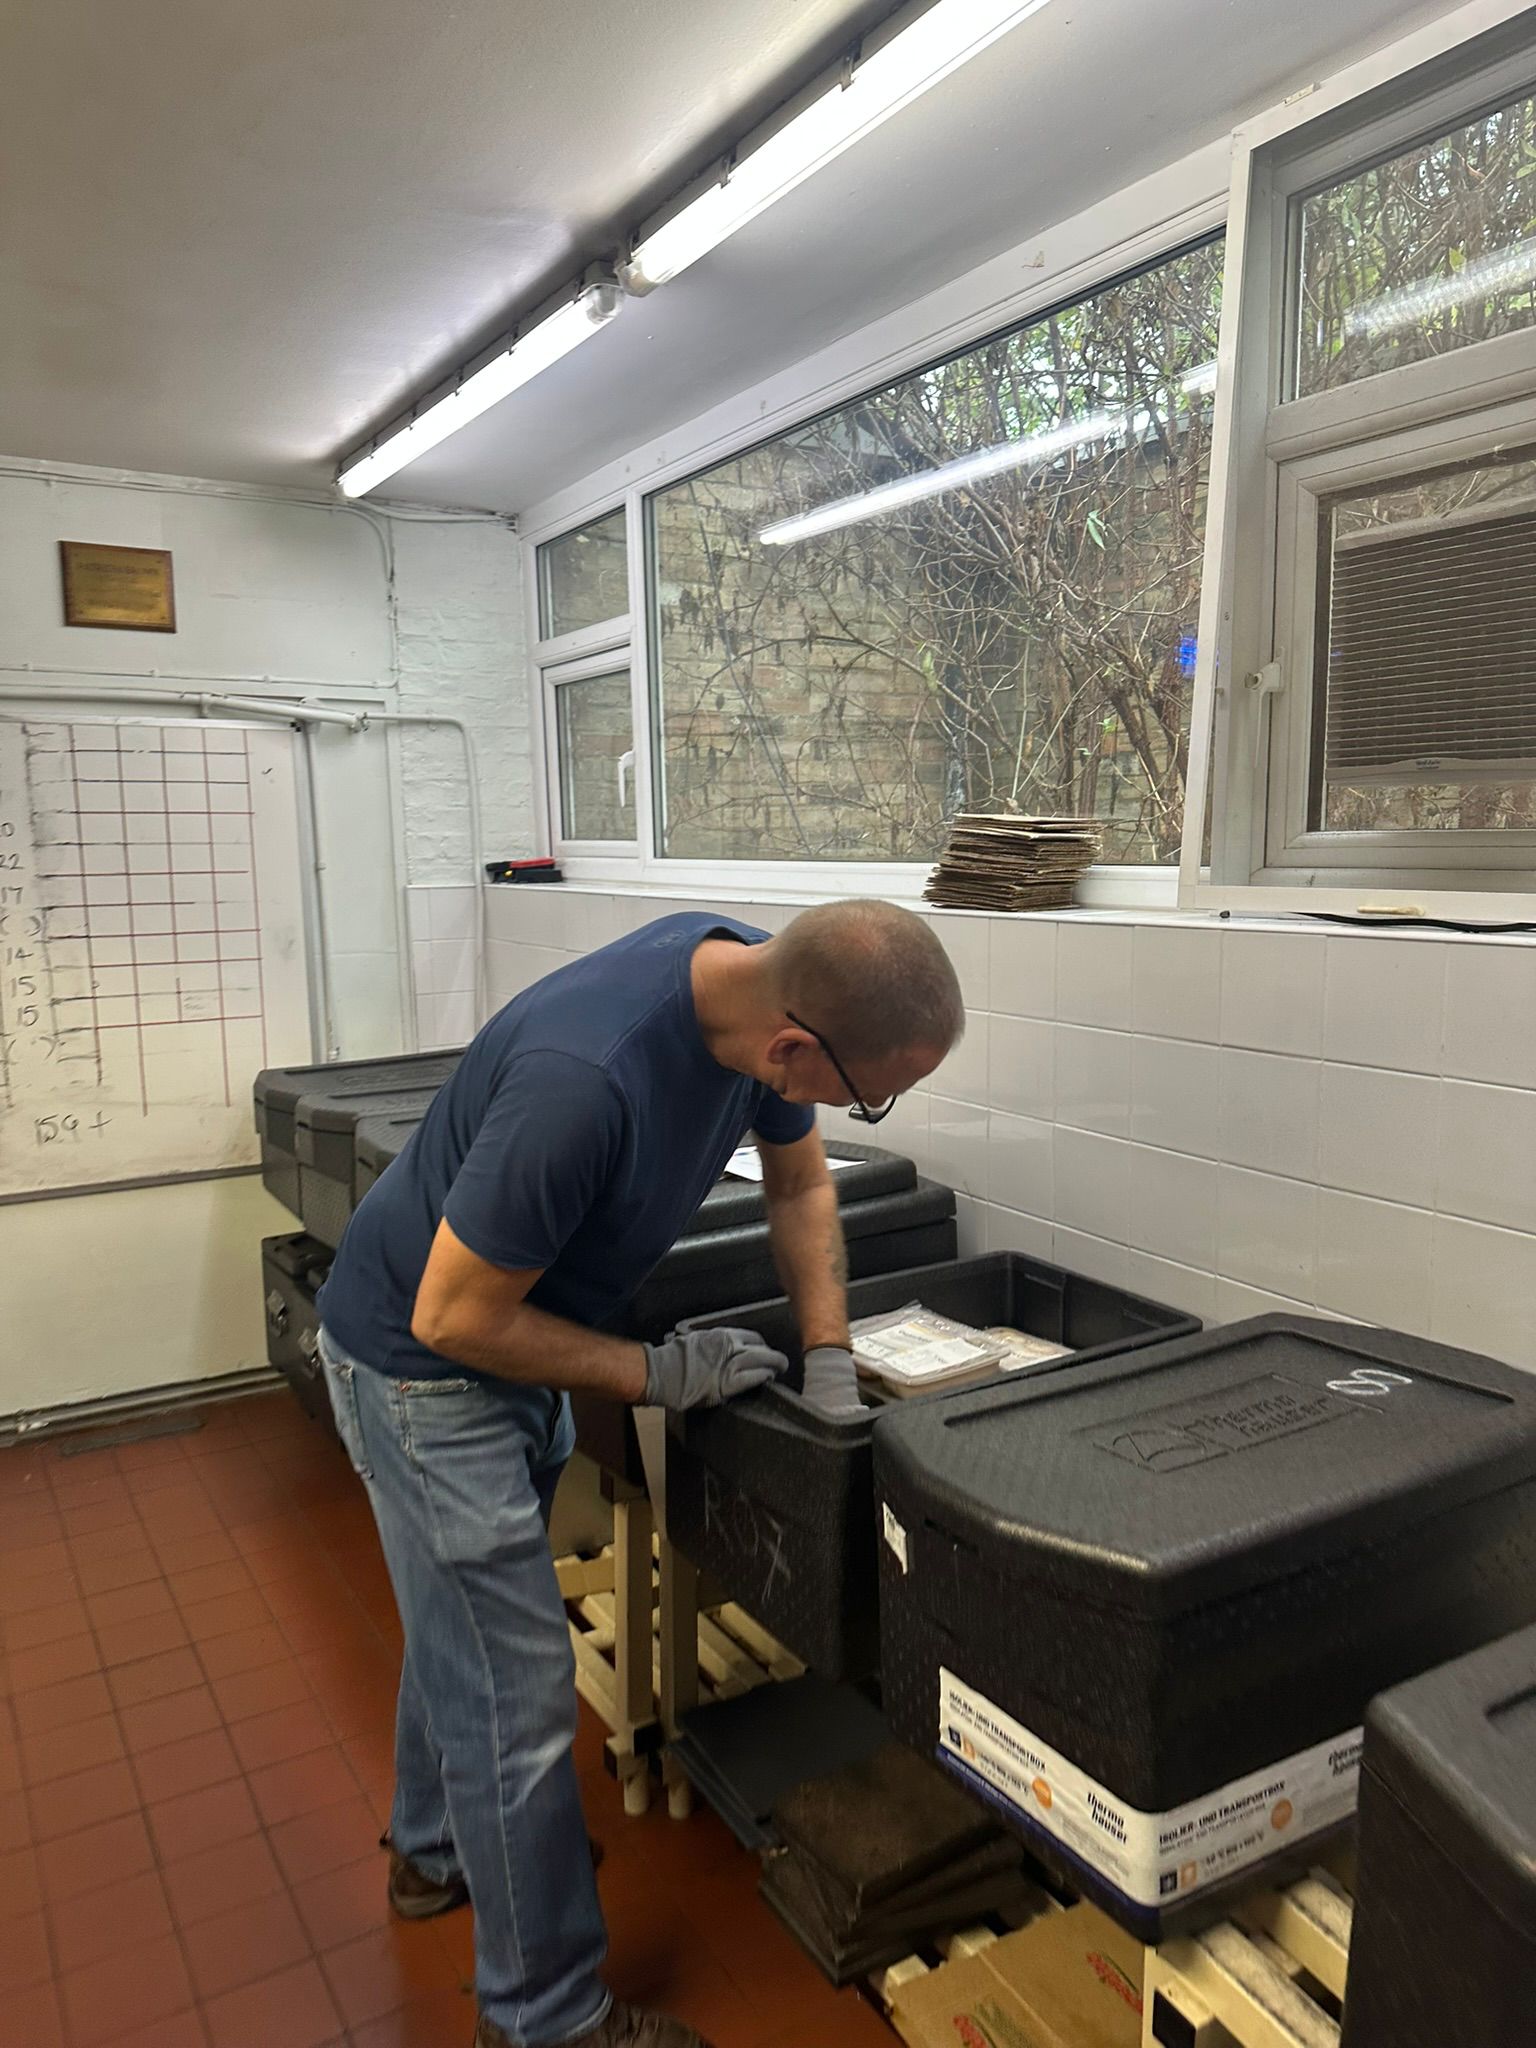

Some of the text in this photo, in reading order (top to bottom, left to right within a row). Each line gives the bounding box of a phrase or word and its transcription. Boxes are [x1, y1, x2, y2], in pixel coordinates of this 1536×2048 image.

[6, 947, 35, 966] 14
[10, 975, 37, 998] 15
[17, 1004, 39, 1027] 15
[1086, 1791, 1125, 1829] thermo
[1091, 1803, 1128, 1845] hauser
